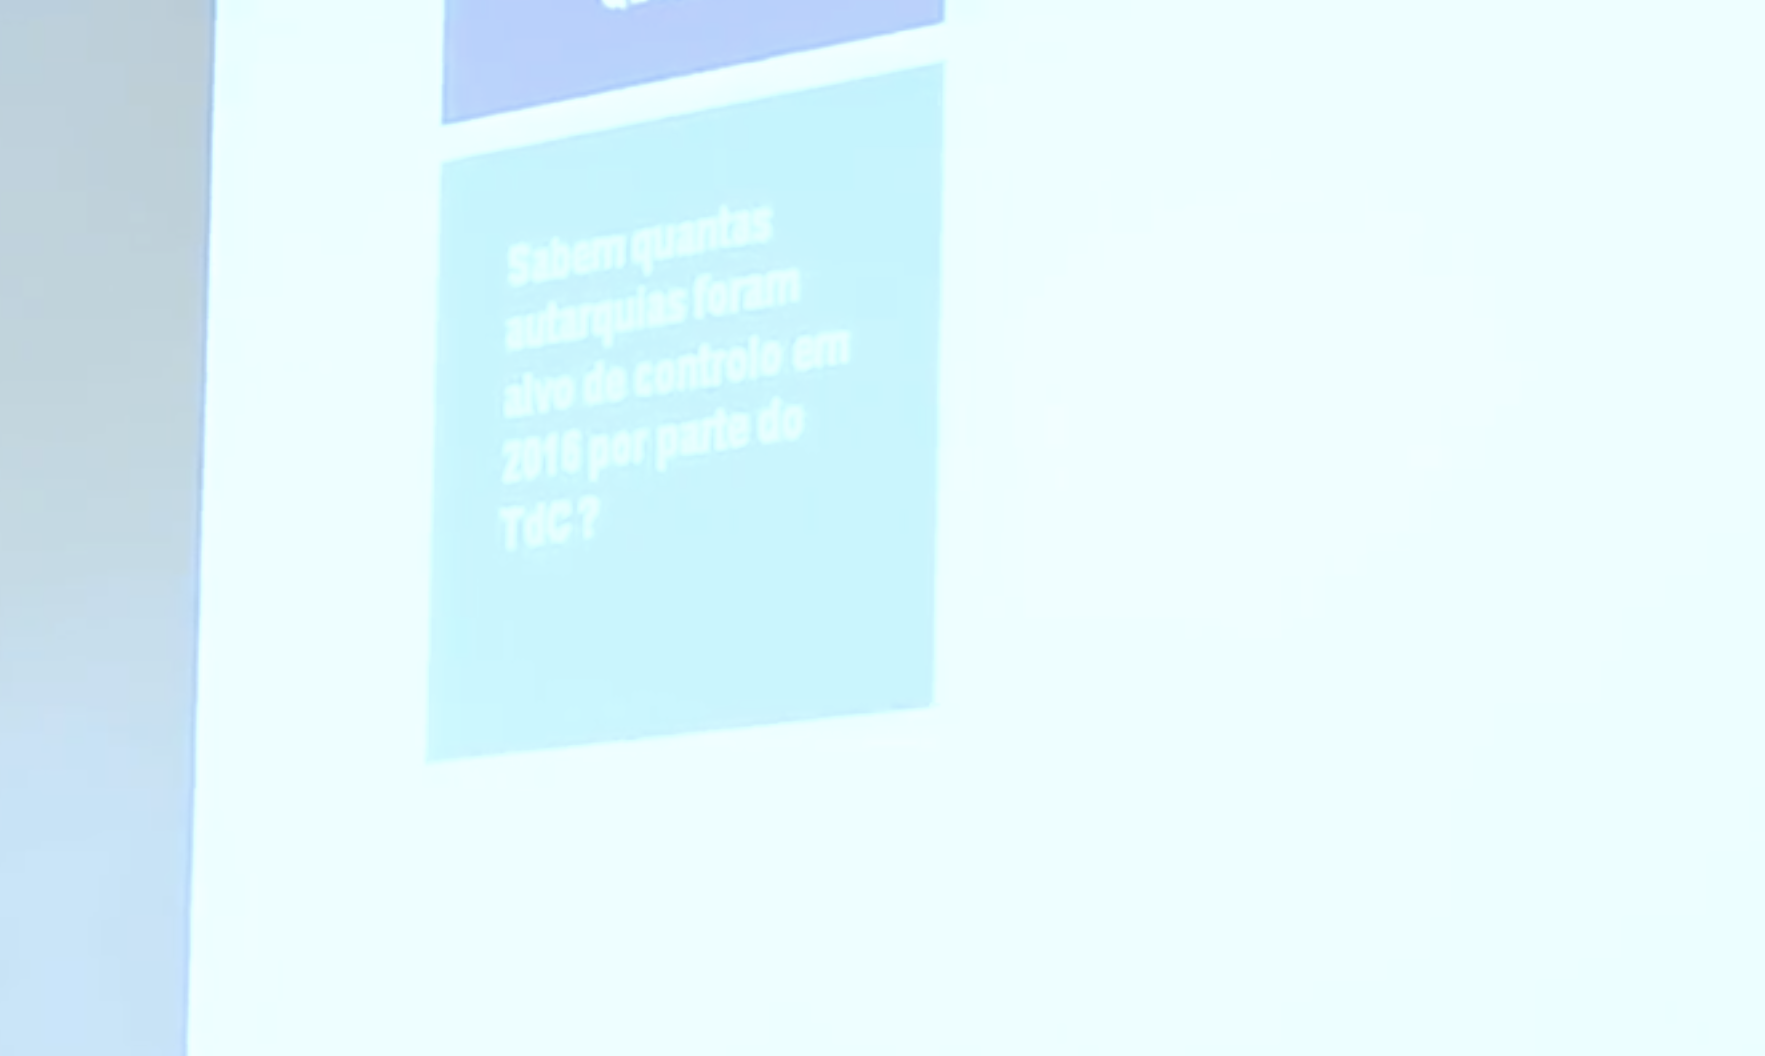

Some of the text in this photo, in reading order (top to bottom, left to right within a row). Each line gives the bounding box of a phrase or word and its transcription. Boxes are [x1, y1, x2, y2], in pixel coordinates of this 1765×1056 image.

[507, 203, 773, 287] Sabem quantas
[504, 267, 802, 351] autarquias foram
[502, 329, 852, 419] alvo de controlo em
[501, 396, 806, 485] 2016 por parte do
[498, 498, 574, 552] TdC
